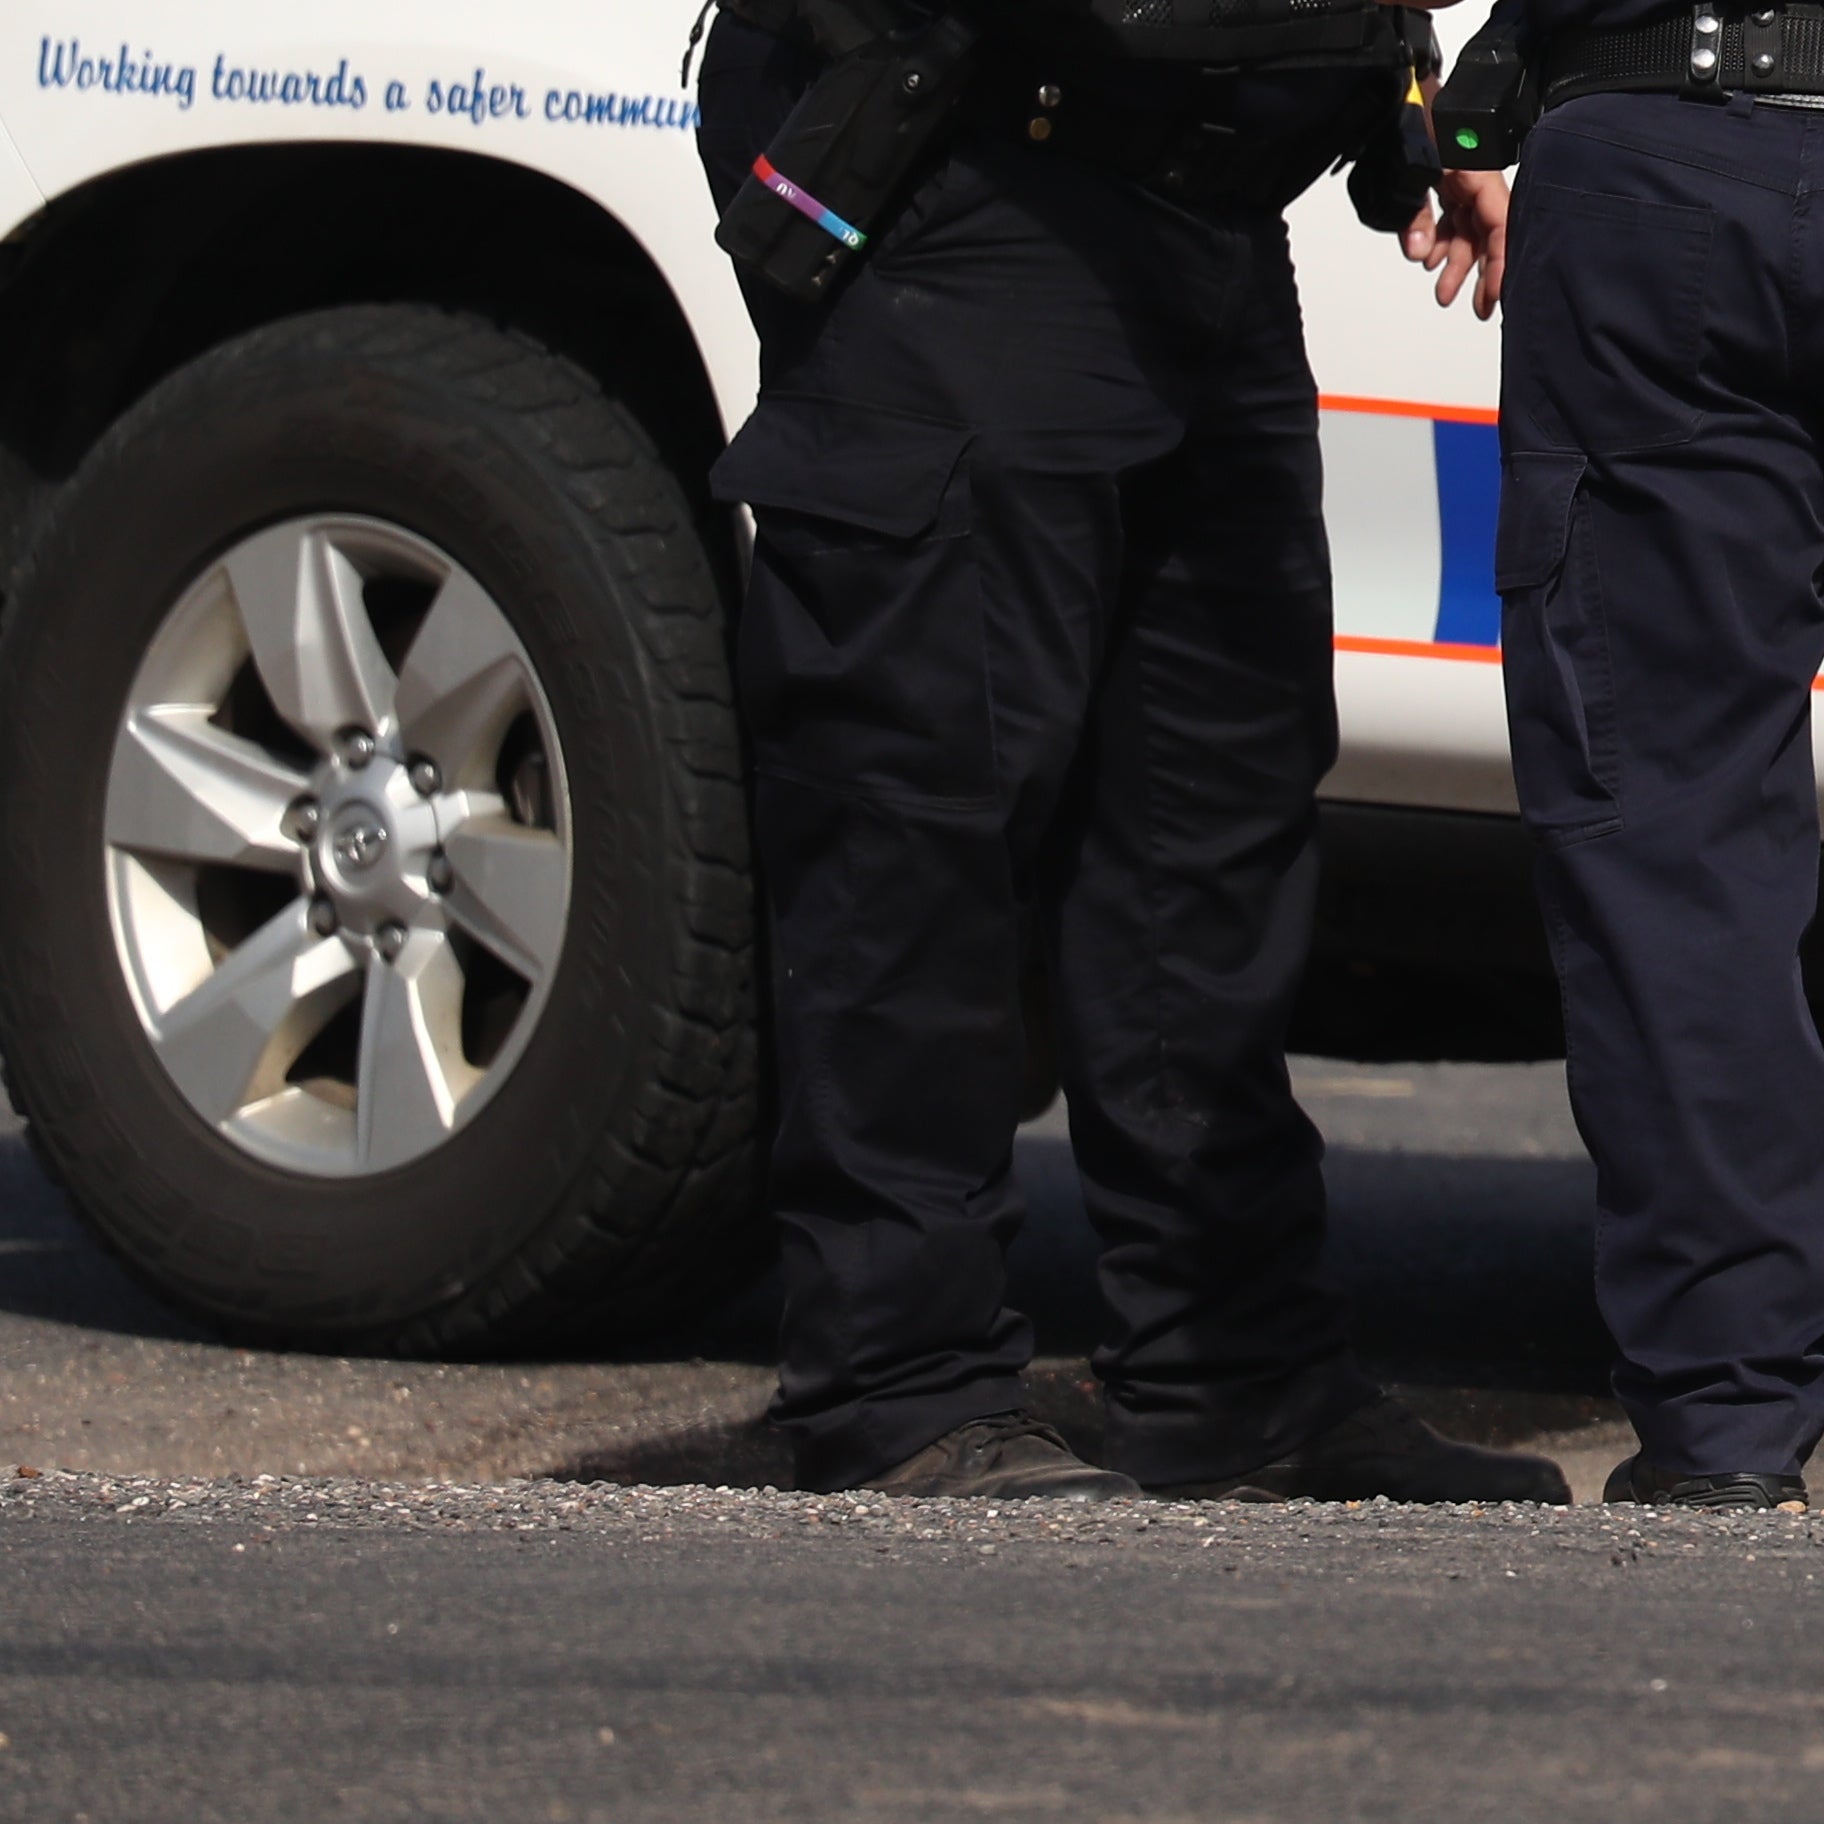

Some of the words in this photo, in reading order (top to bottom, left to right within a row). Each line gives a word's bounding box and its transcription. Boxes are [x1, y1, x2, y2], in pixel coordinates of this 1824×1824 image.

[37, 35, 196, 109] Working
[211, 53, 369, 110] towards
[383, 80, 410, 110] a
[425, 67, 533, 128] safer
[543, 92, 701, 131] commun
